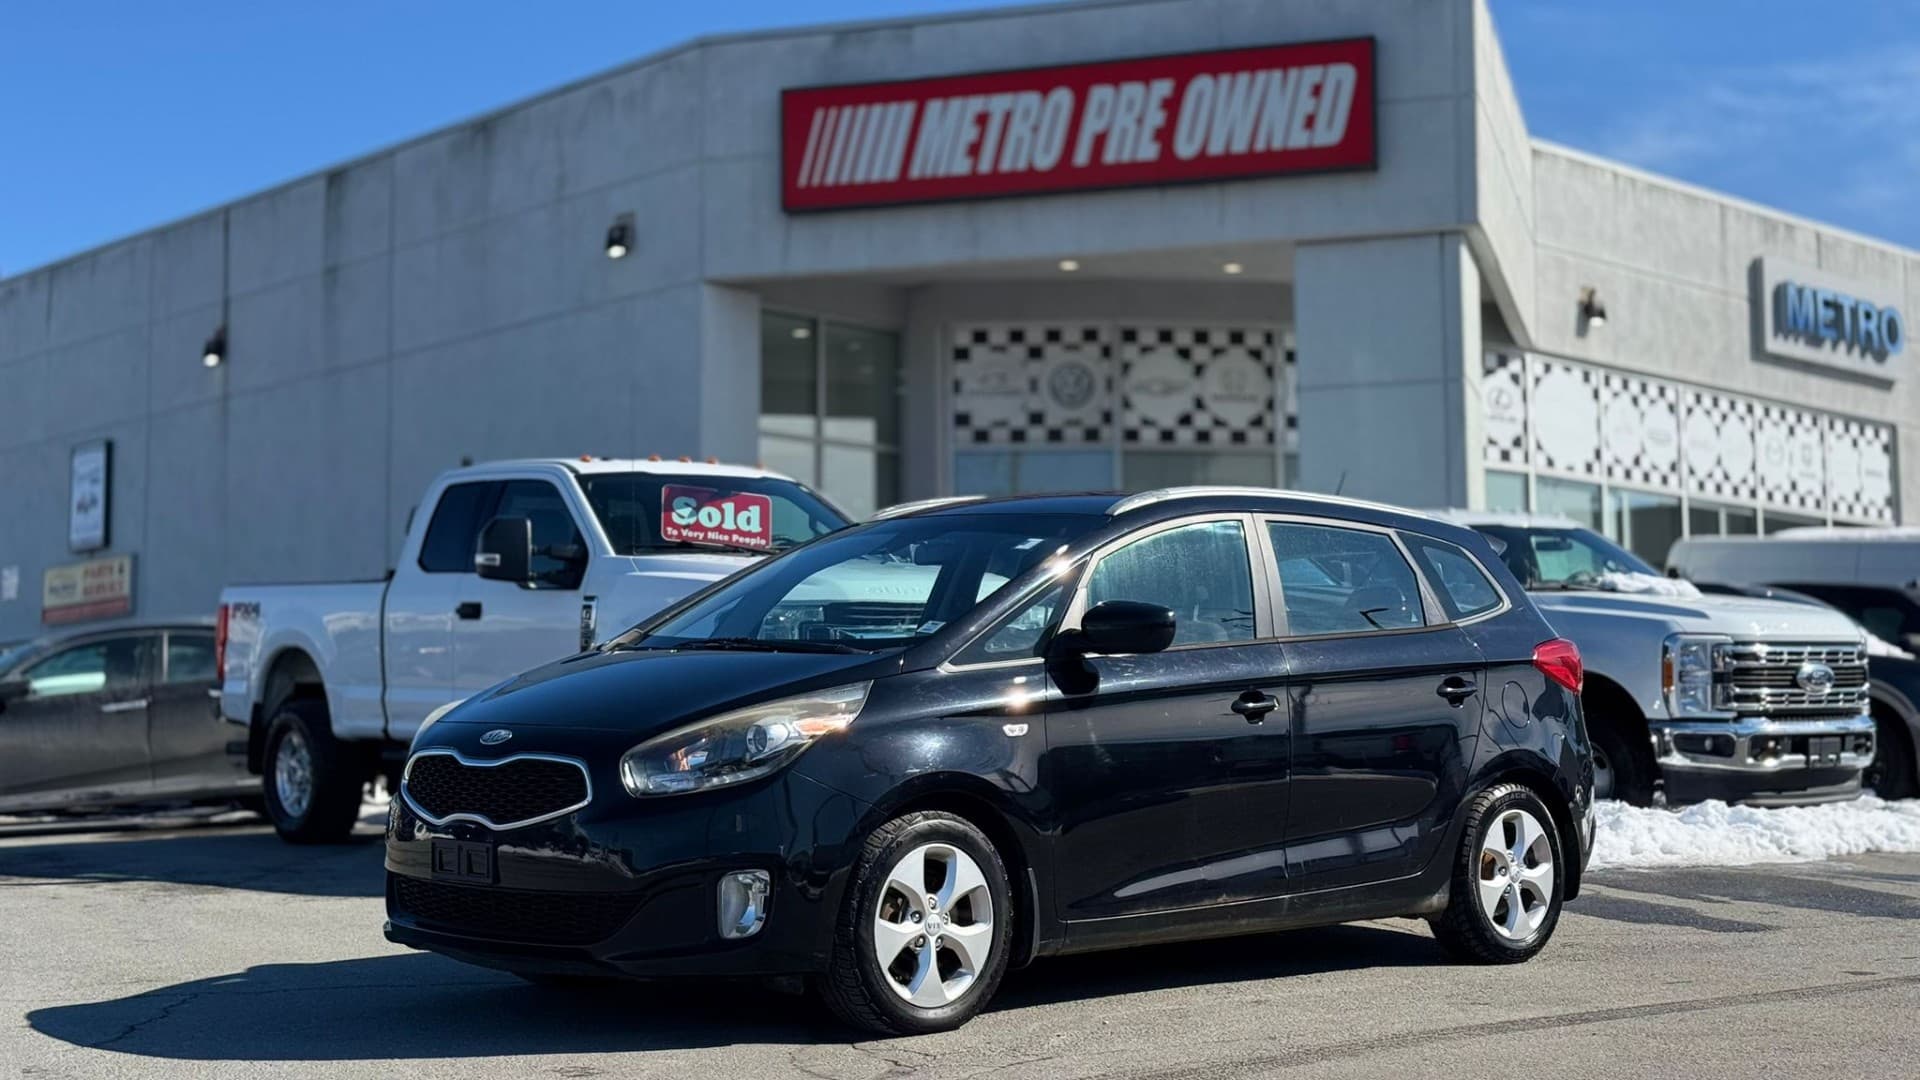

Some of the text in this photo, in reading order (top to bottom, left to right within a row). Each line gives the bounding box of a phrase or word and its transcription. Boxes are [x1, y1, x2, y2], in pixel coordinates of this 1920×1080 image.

[909, 63, 1357, 180] METRO PRE OWNED
[1786, 280, 1904, 356] METRO
[666, 527, 766, 545] To Very Nice People
[671, 496, 762, 533] Sold
